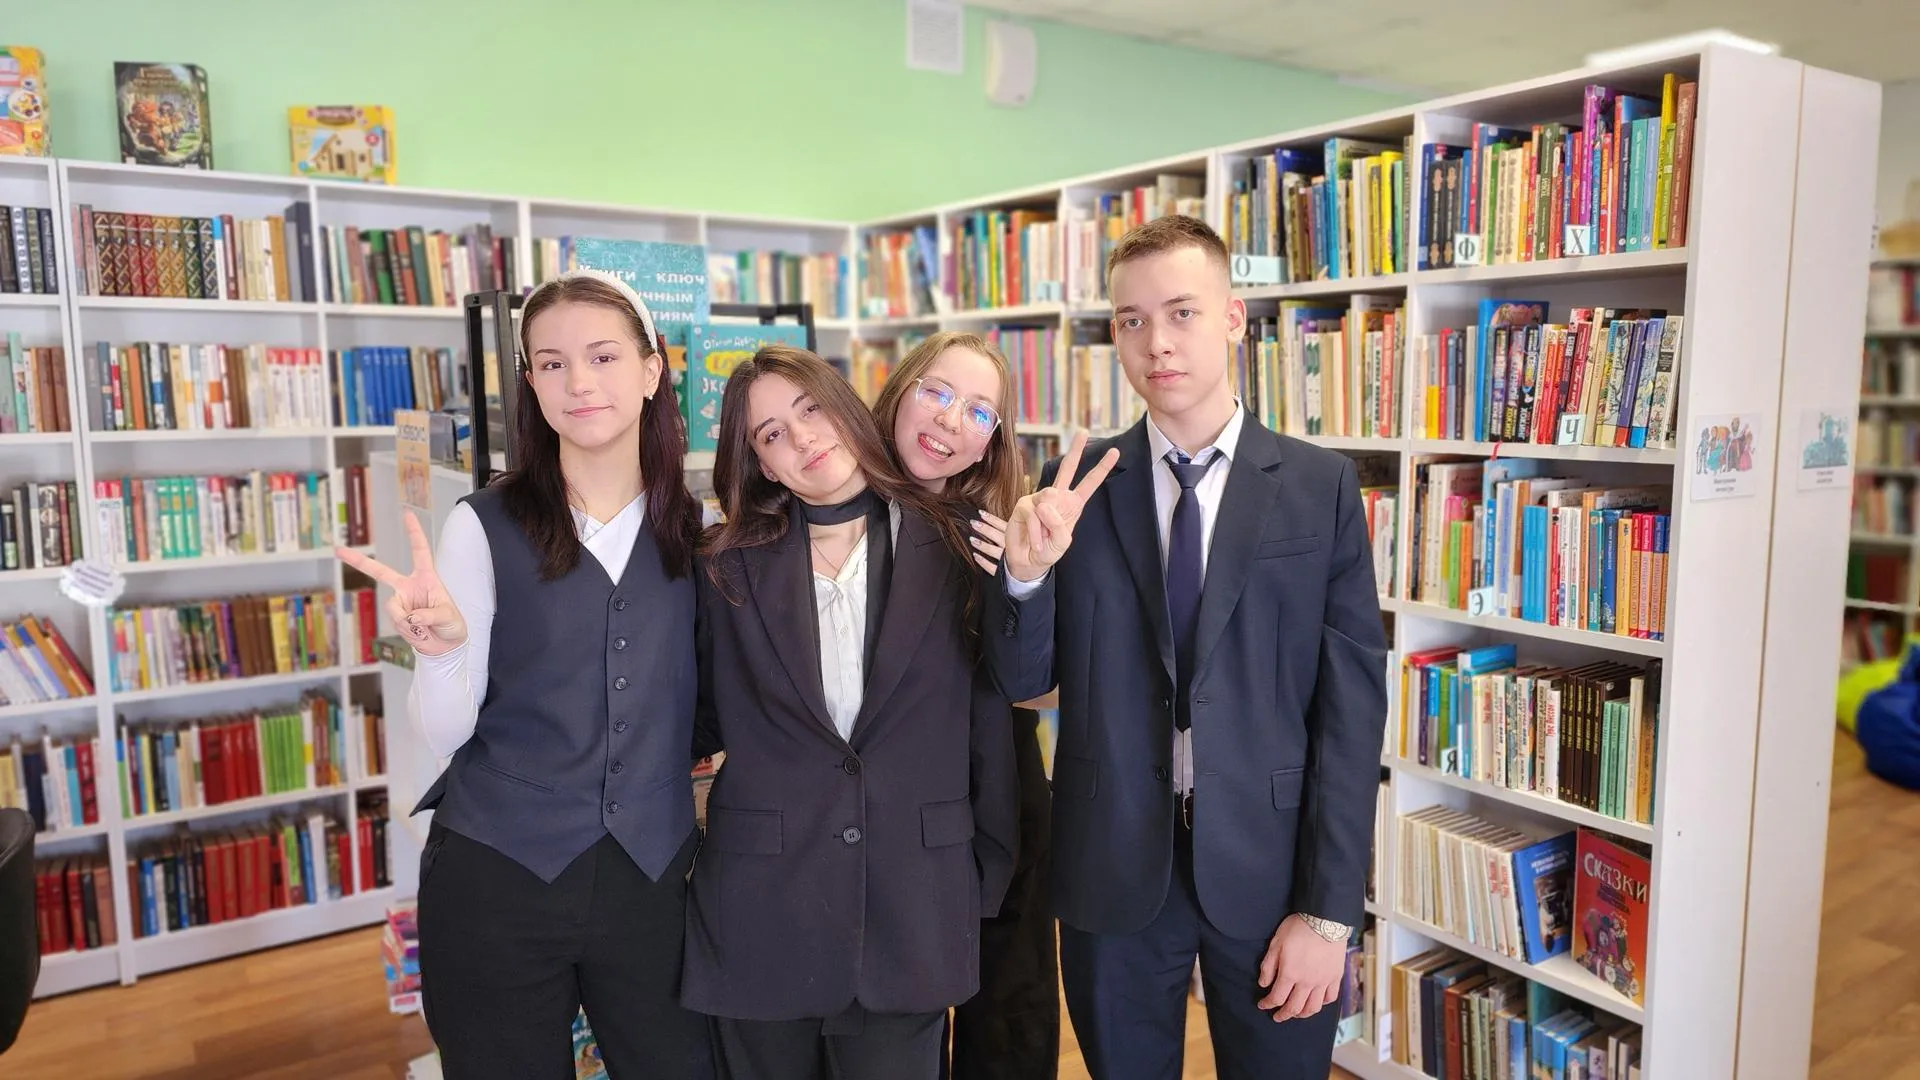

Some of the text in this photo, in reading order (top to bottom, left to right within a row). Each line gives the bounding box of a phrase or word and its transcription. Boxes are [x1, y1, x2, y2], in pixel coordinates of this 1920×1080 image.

[1458, 237, 1475, 260] Ф
[1571, 229, 1584, 253] Х
[579, 265, 636, 280] Киги
[656, 272, 704, 284] ключ
[1235, 255, 1251, 277] О
[652, 311, 694, 322] тиям
[1565, 418, 1581, 443] Ч
[1471, 592, 1484, 616] Э
[1447, 749, 1459, 773] Я
[1584, 852, 1647, 903] СКАЗКИ
